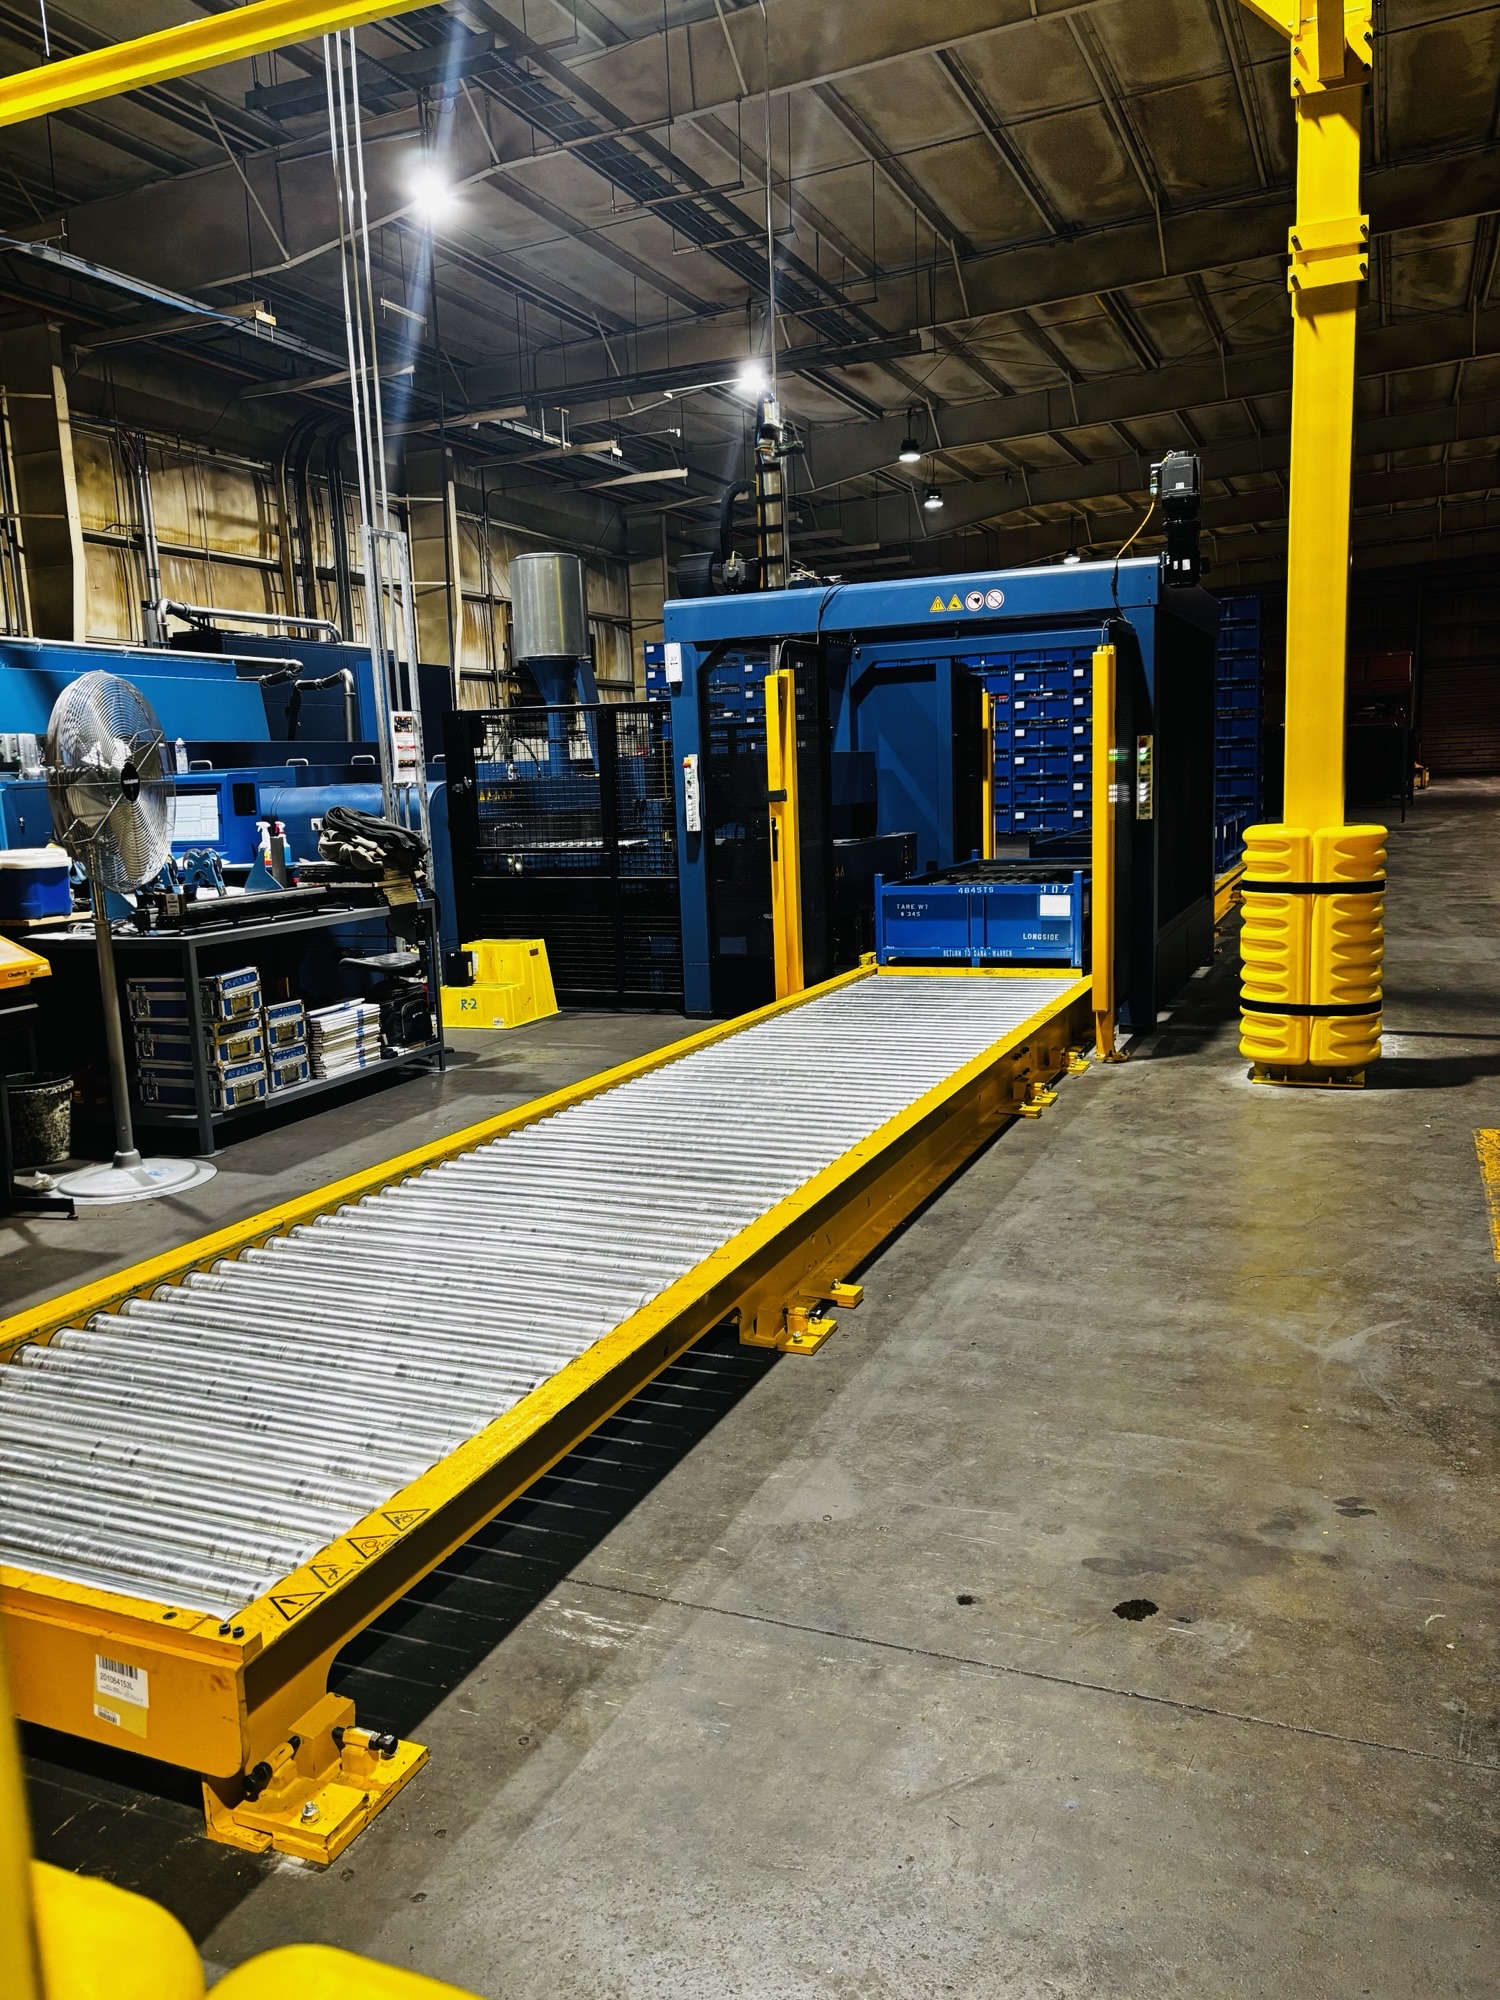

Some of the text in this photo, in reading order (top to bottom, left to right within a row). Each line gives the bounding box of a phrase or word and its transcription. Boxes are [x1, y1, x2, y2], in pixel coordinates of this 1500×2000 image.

[1022, 932, 1059, 941] LONGSIDE
[943, 949, 962, 957] RETURN
[964, 949, 971, 957] TO
[460, 997, 478, 1011] R-2
